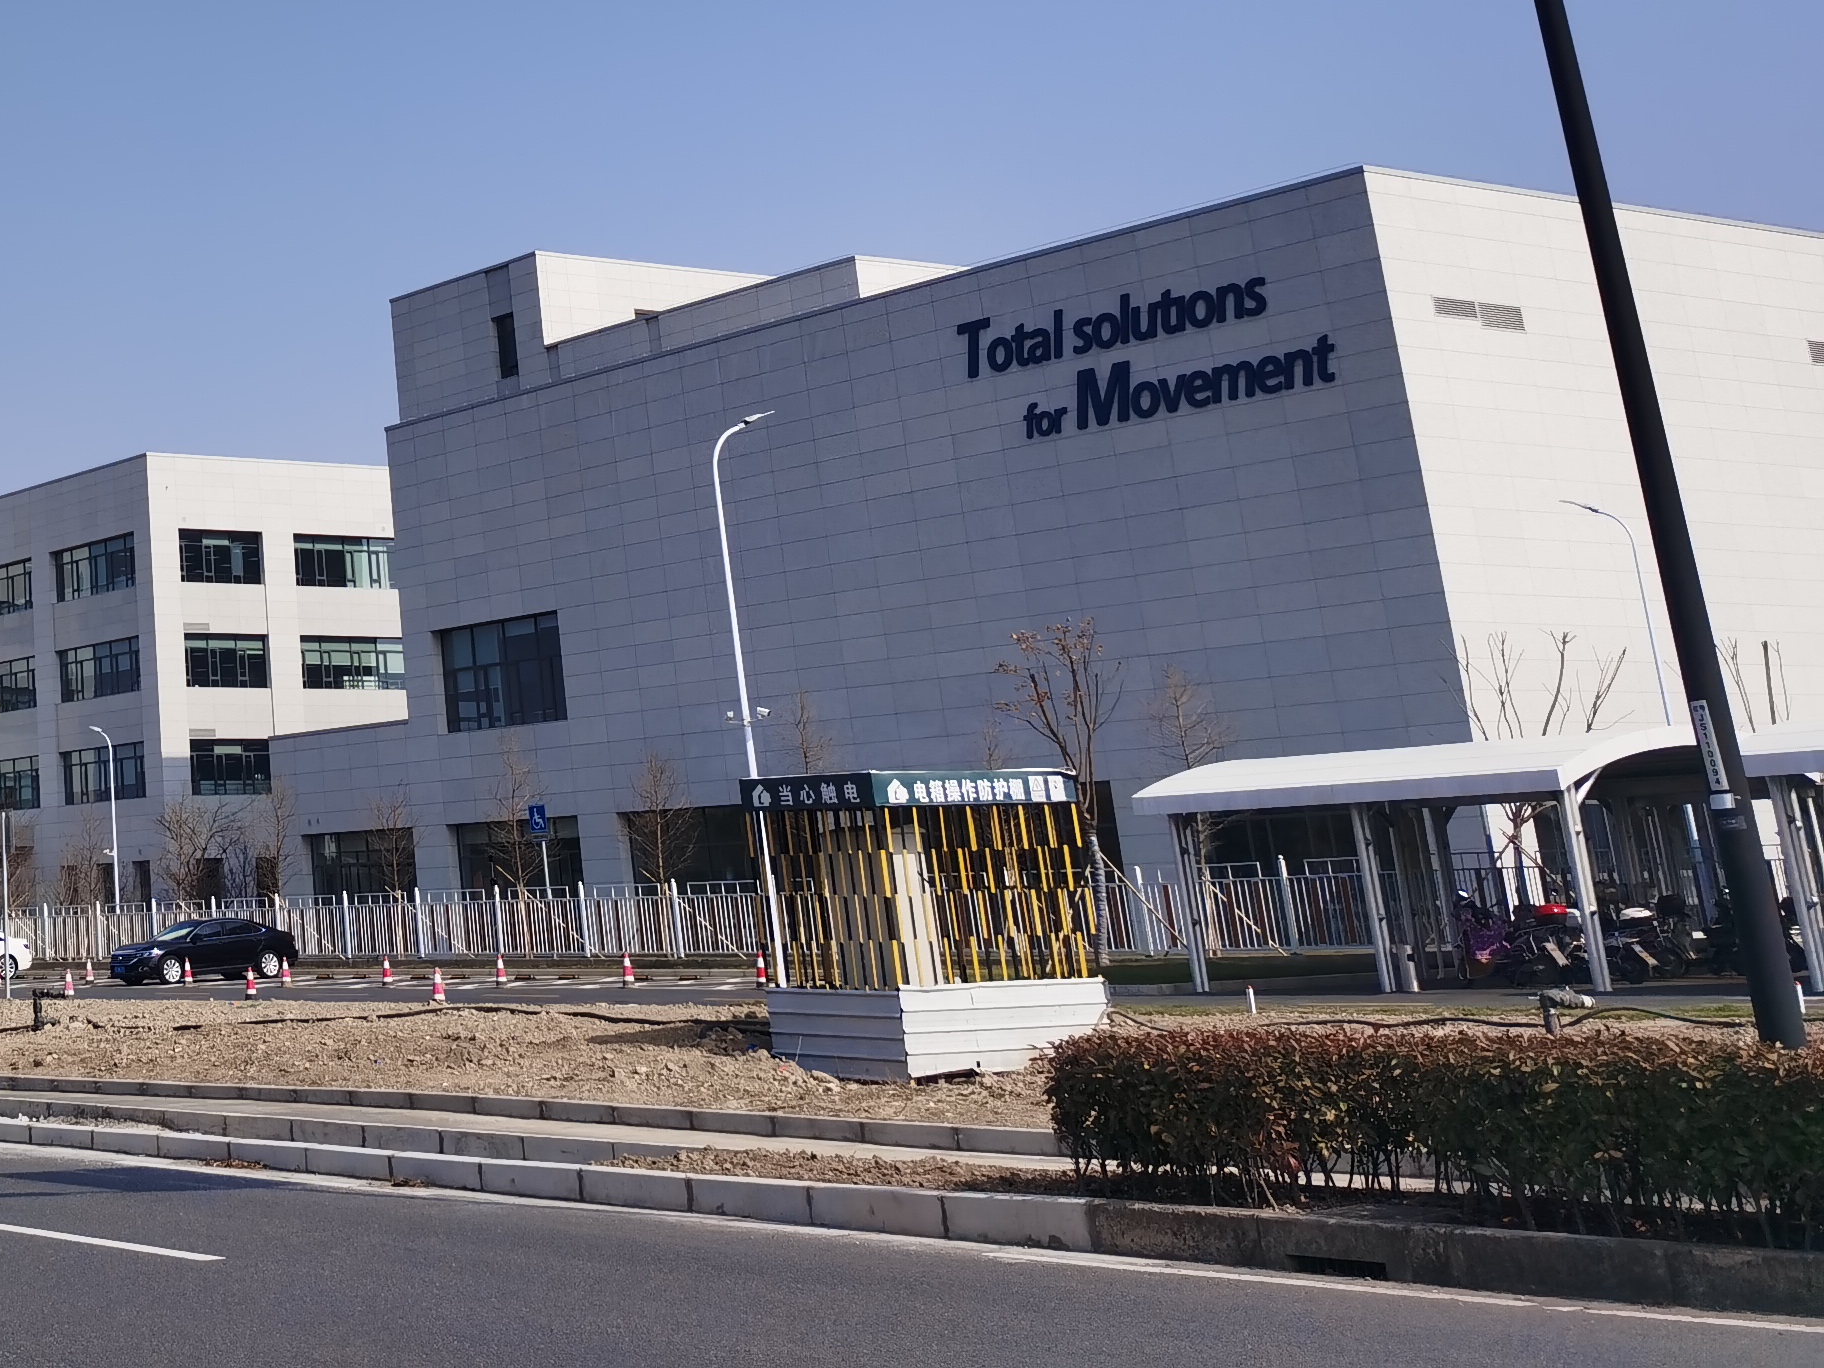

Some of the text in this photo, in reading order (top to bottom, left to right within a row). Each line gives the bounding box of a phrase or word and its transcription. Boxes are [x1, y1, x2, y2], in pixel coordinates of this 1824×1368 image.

[956, 276, 1267, 379] Total solutions
[1023, 334, 1336, 439] for Movement
[778, 781, 861, 805] 当心触电
[913, 778, 1026, 803] 电箱操作防护棚
